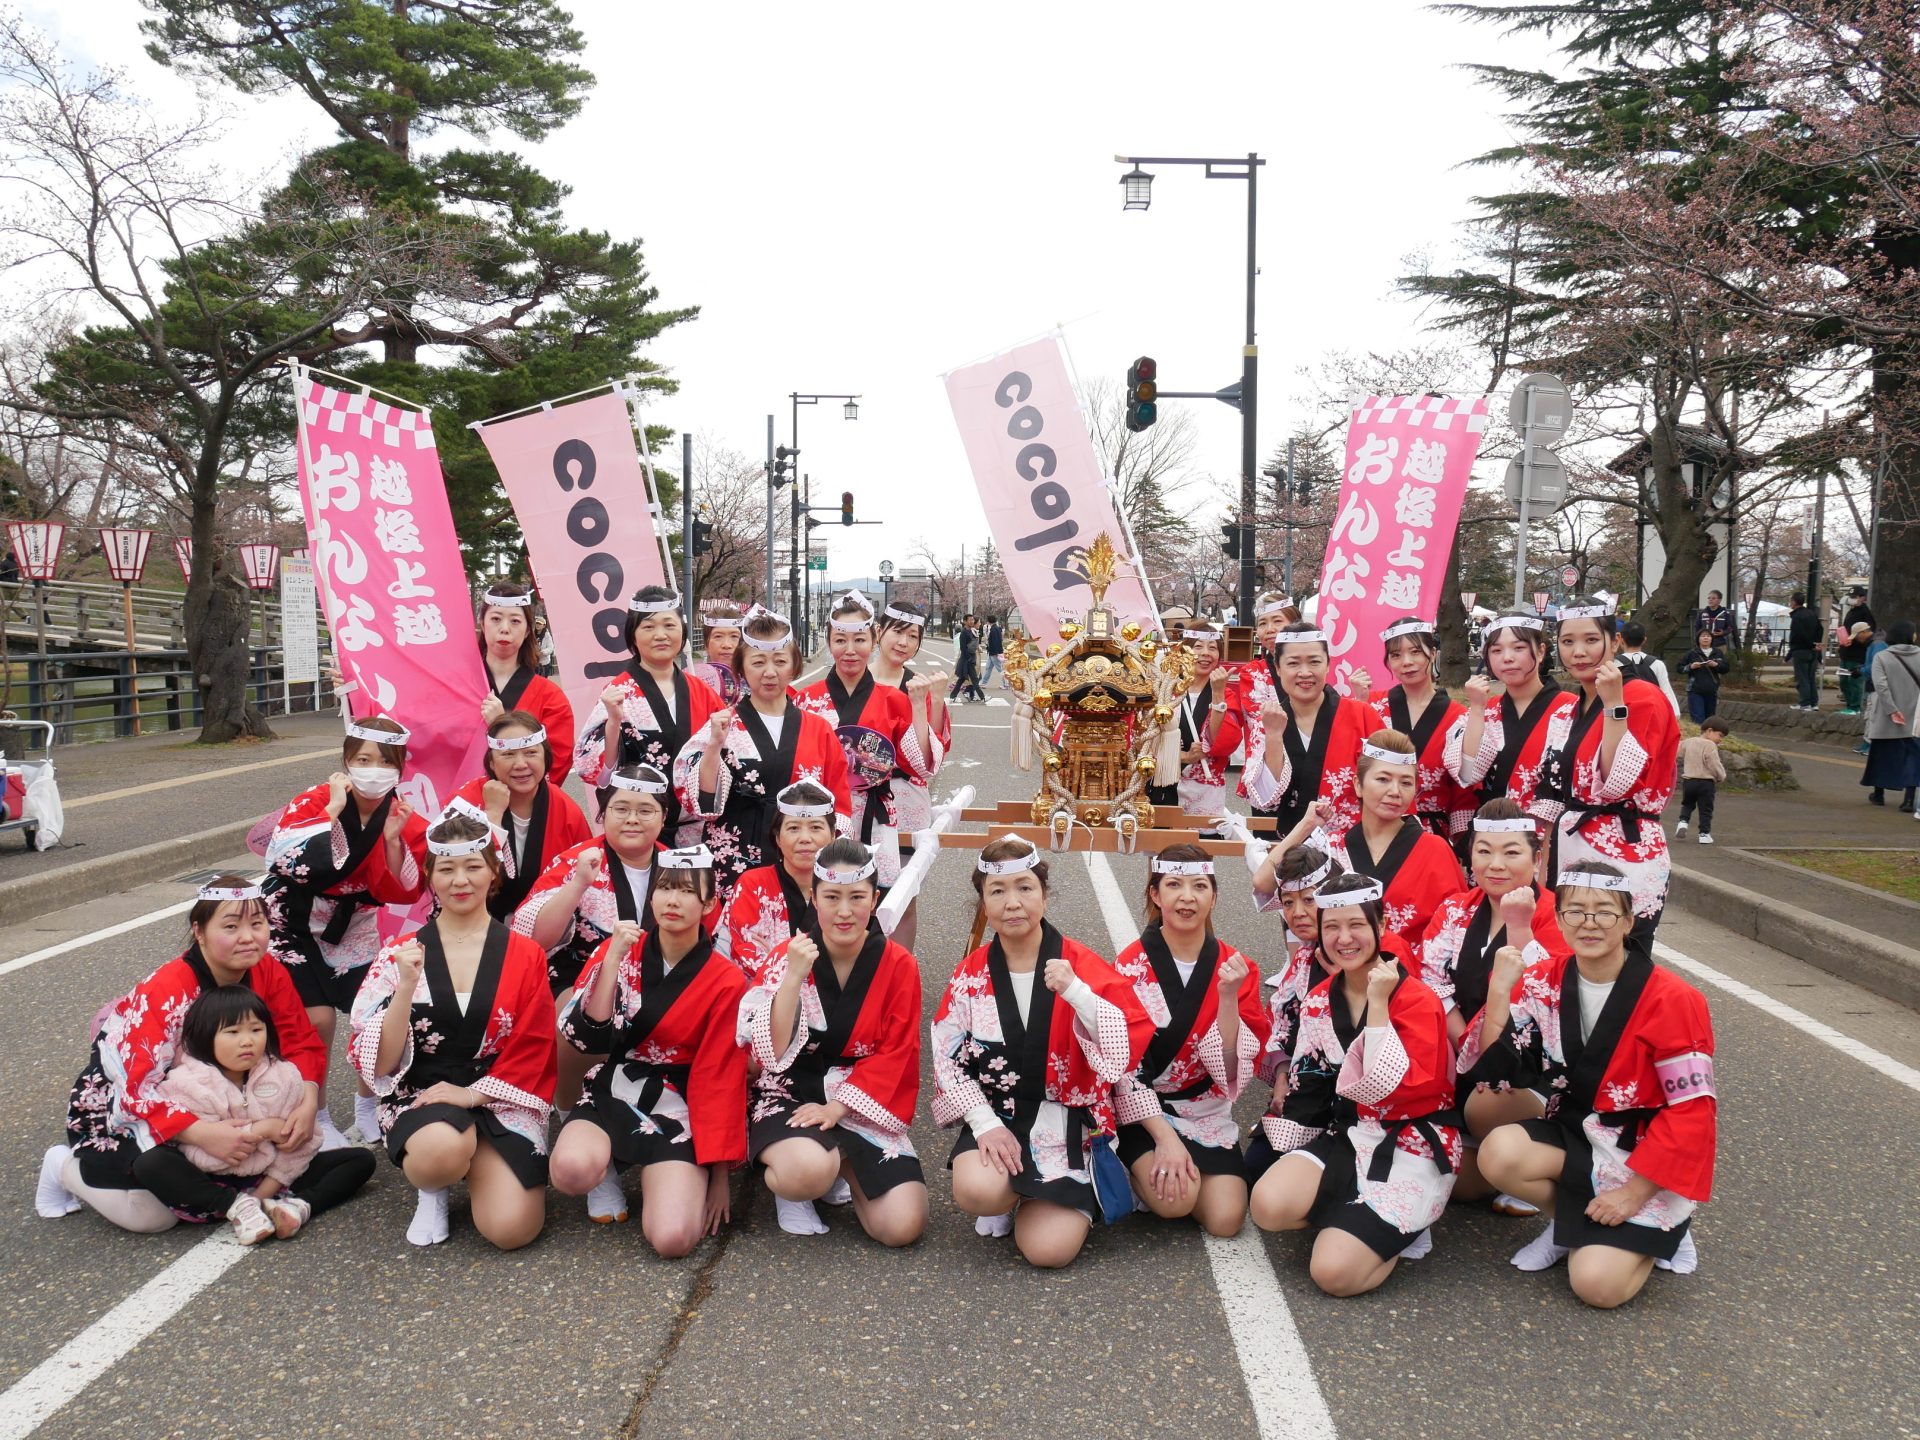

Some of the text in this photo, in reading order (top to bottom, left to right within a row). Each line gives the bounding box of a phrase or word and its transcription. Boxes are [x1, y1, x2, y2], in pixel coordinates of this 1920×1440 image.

[370, 454, 448, 646] 越後上越
[1377, 437, 1447, 609] 越後上越
